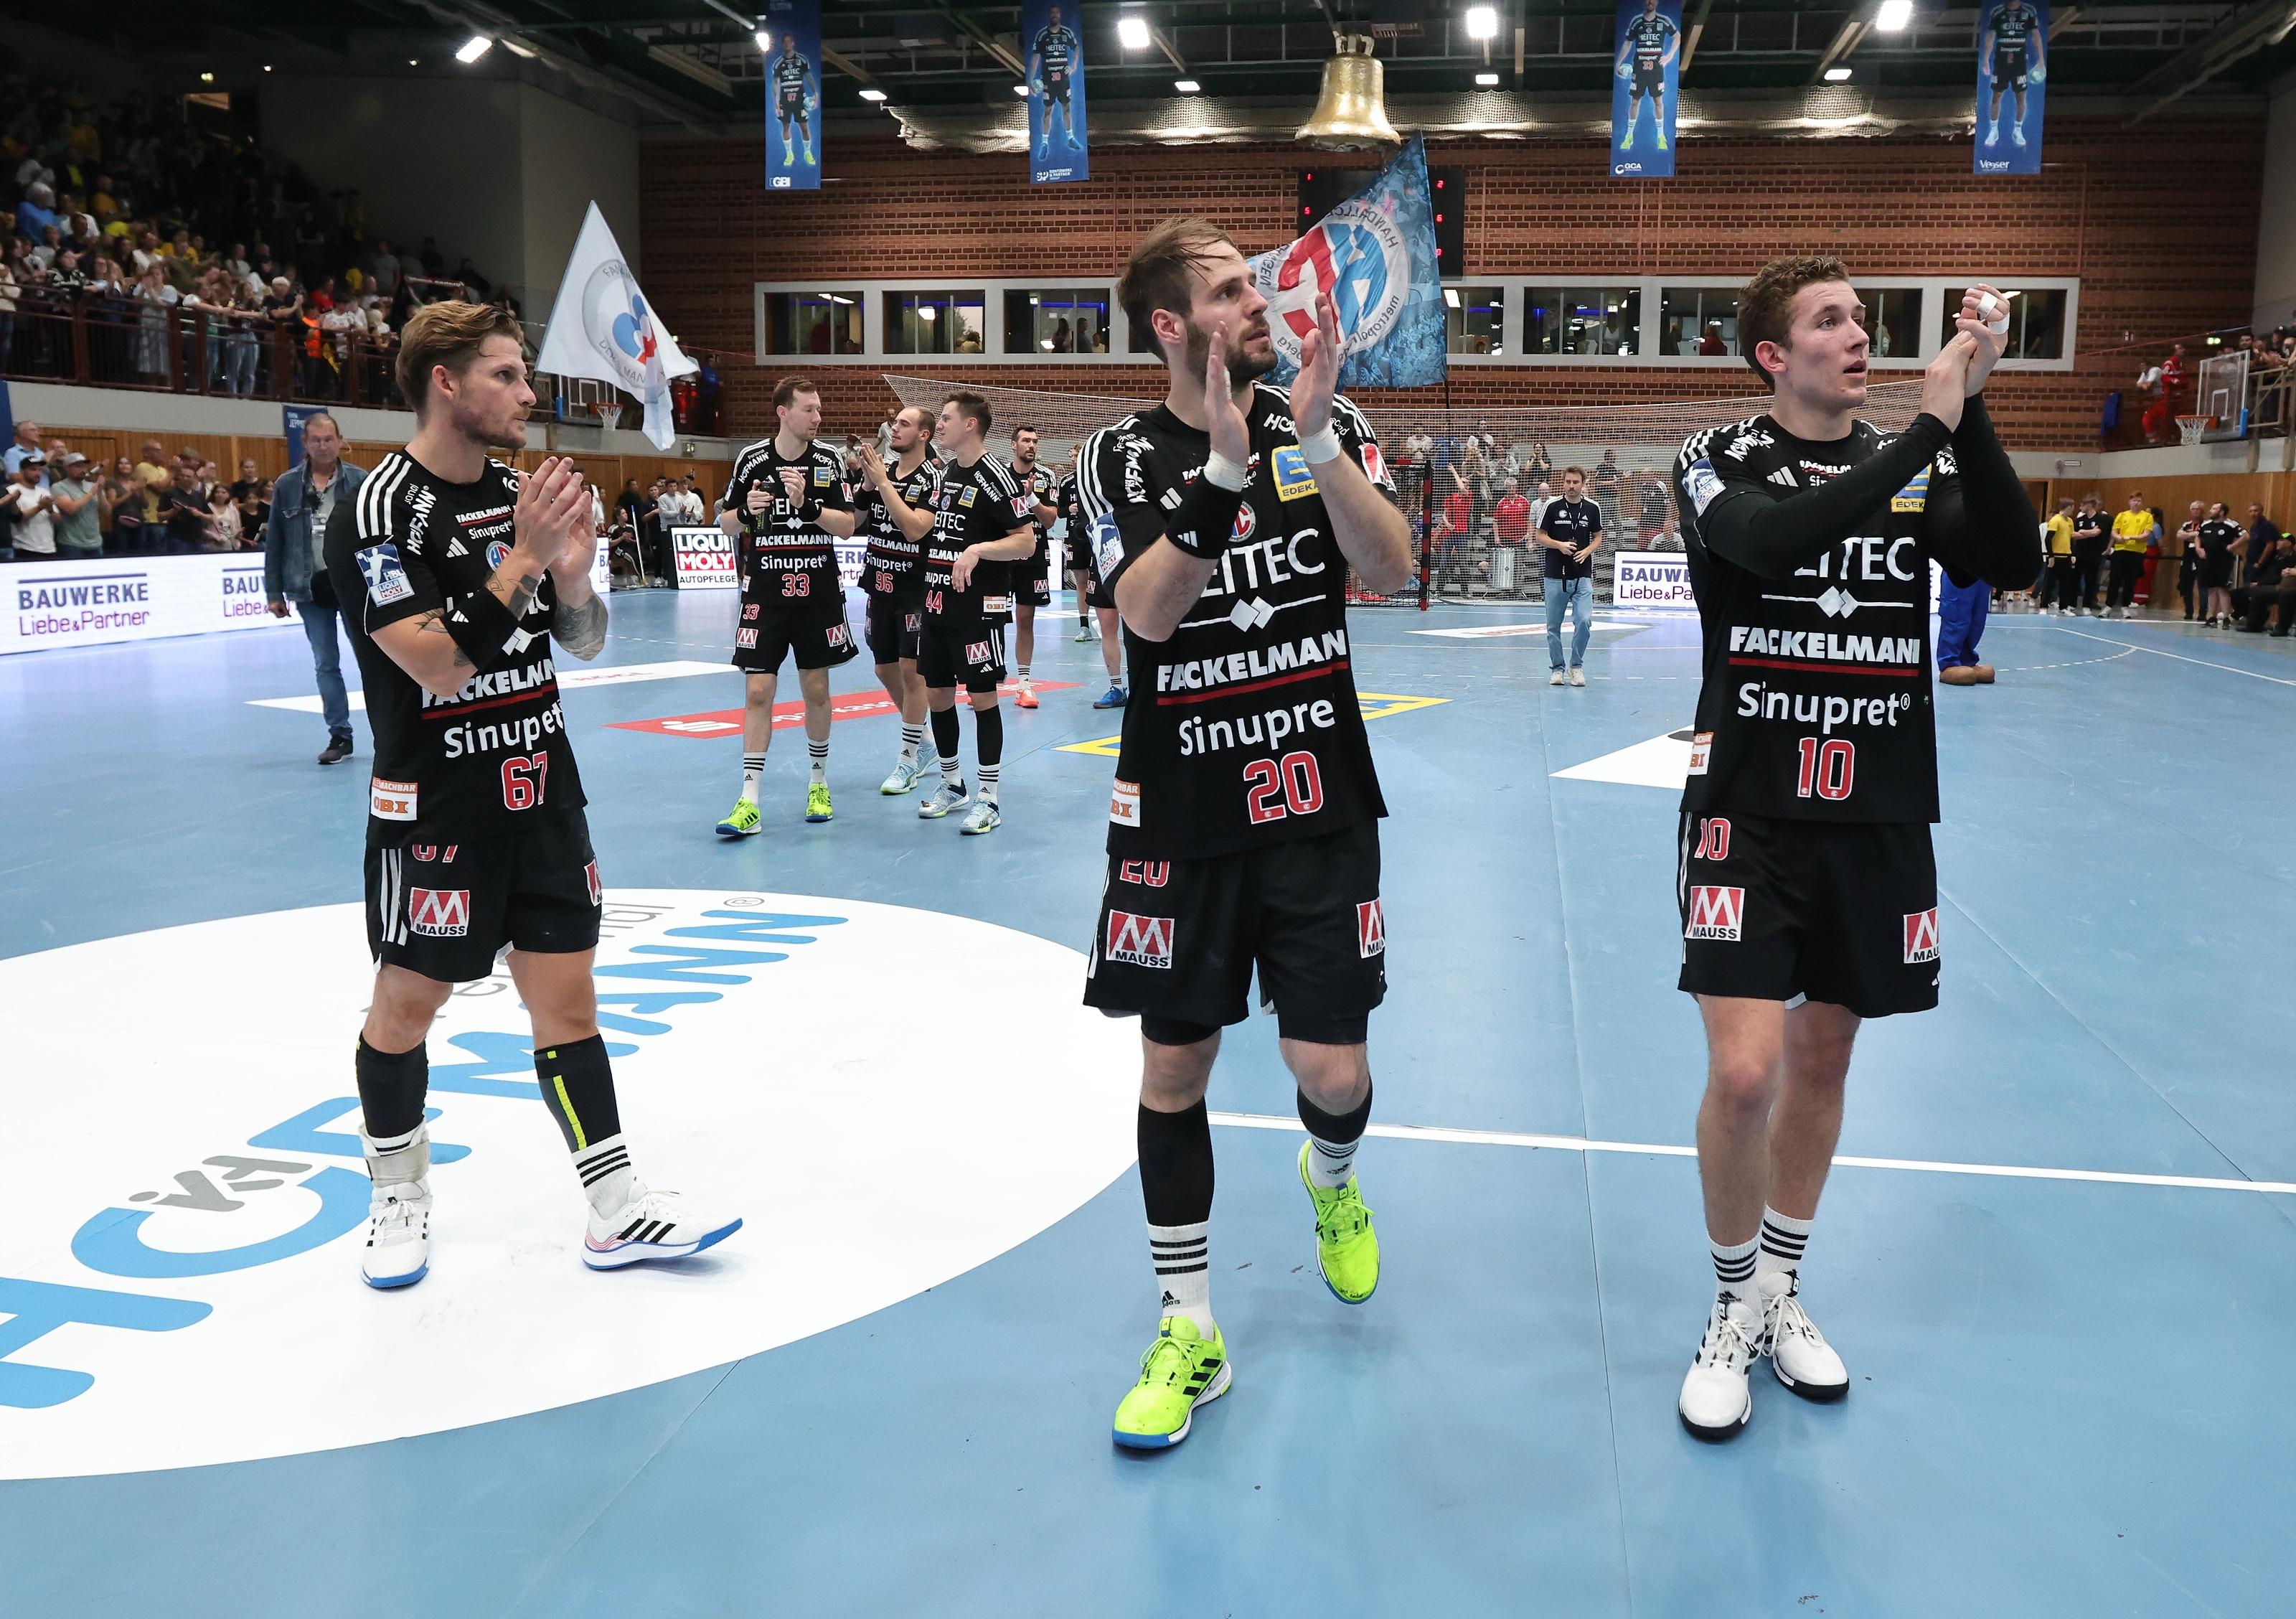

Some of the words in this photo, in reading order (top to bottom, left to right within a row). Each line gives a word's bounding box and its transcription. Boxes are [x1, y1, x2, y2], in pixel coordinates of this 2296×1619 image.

[1282, 483, 1317, 497] EDEK
[934, 510, 966, 532] EITEC
[676, 534, 730, 552] LIQUI
[756, 534, 833, 547] FACKELMANN
[678, 552, 733, 570] MOLY
[382, 569, 405, 581] HBL
[679, 575, 737, 583] AUTOPFLEGE
[875, 571, 893, 593] 96
[378, 579, 400, 592] LIQUI
[381, 586, 403, 599] MOLY
[781, 573, 810, 597] 33
[18, 583, 149, 610] BAUWERKE
[926, 590, 943, 614] 44
[743, 604, 760, 620] 33
[971, 655, 991, 664] MAUSS
[1689, 753, 1705, 768] BI
[1797, 737, 1855, 800] 10
[501, 750, 547, 811] 67
[1243, 751, 1324, 825] 20
[1110, 799, 1132, 818] BI
[1694, 817, 1731, 861] 10
[416, 923, 466, 936] MAUSS
[1693, 926, 1738, 940] MAUSS
[1114, 949, 1169, 967] MAUSS
